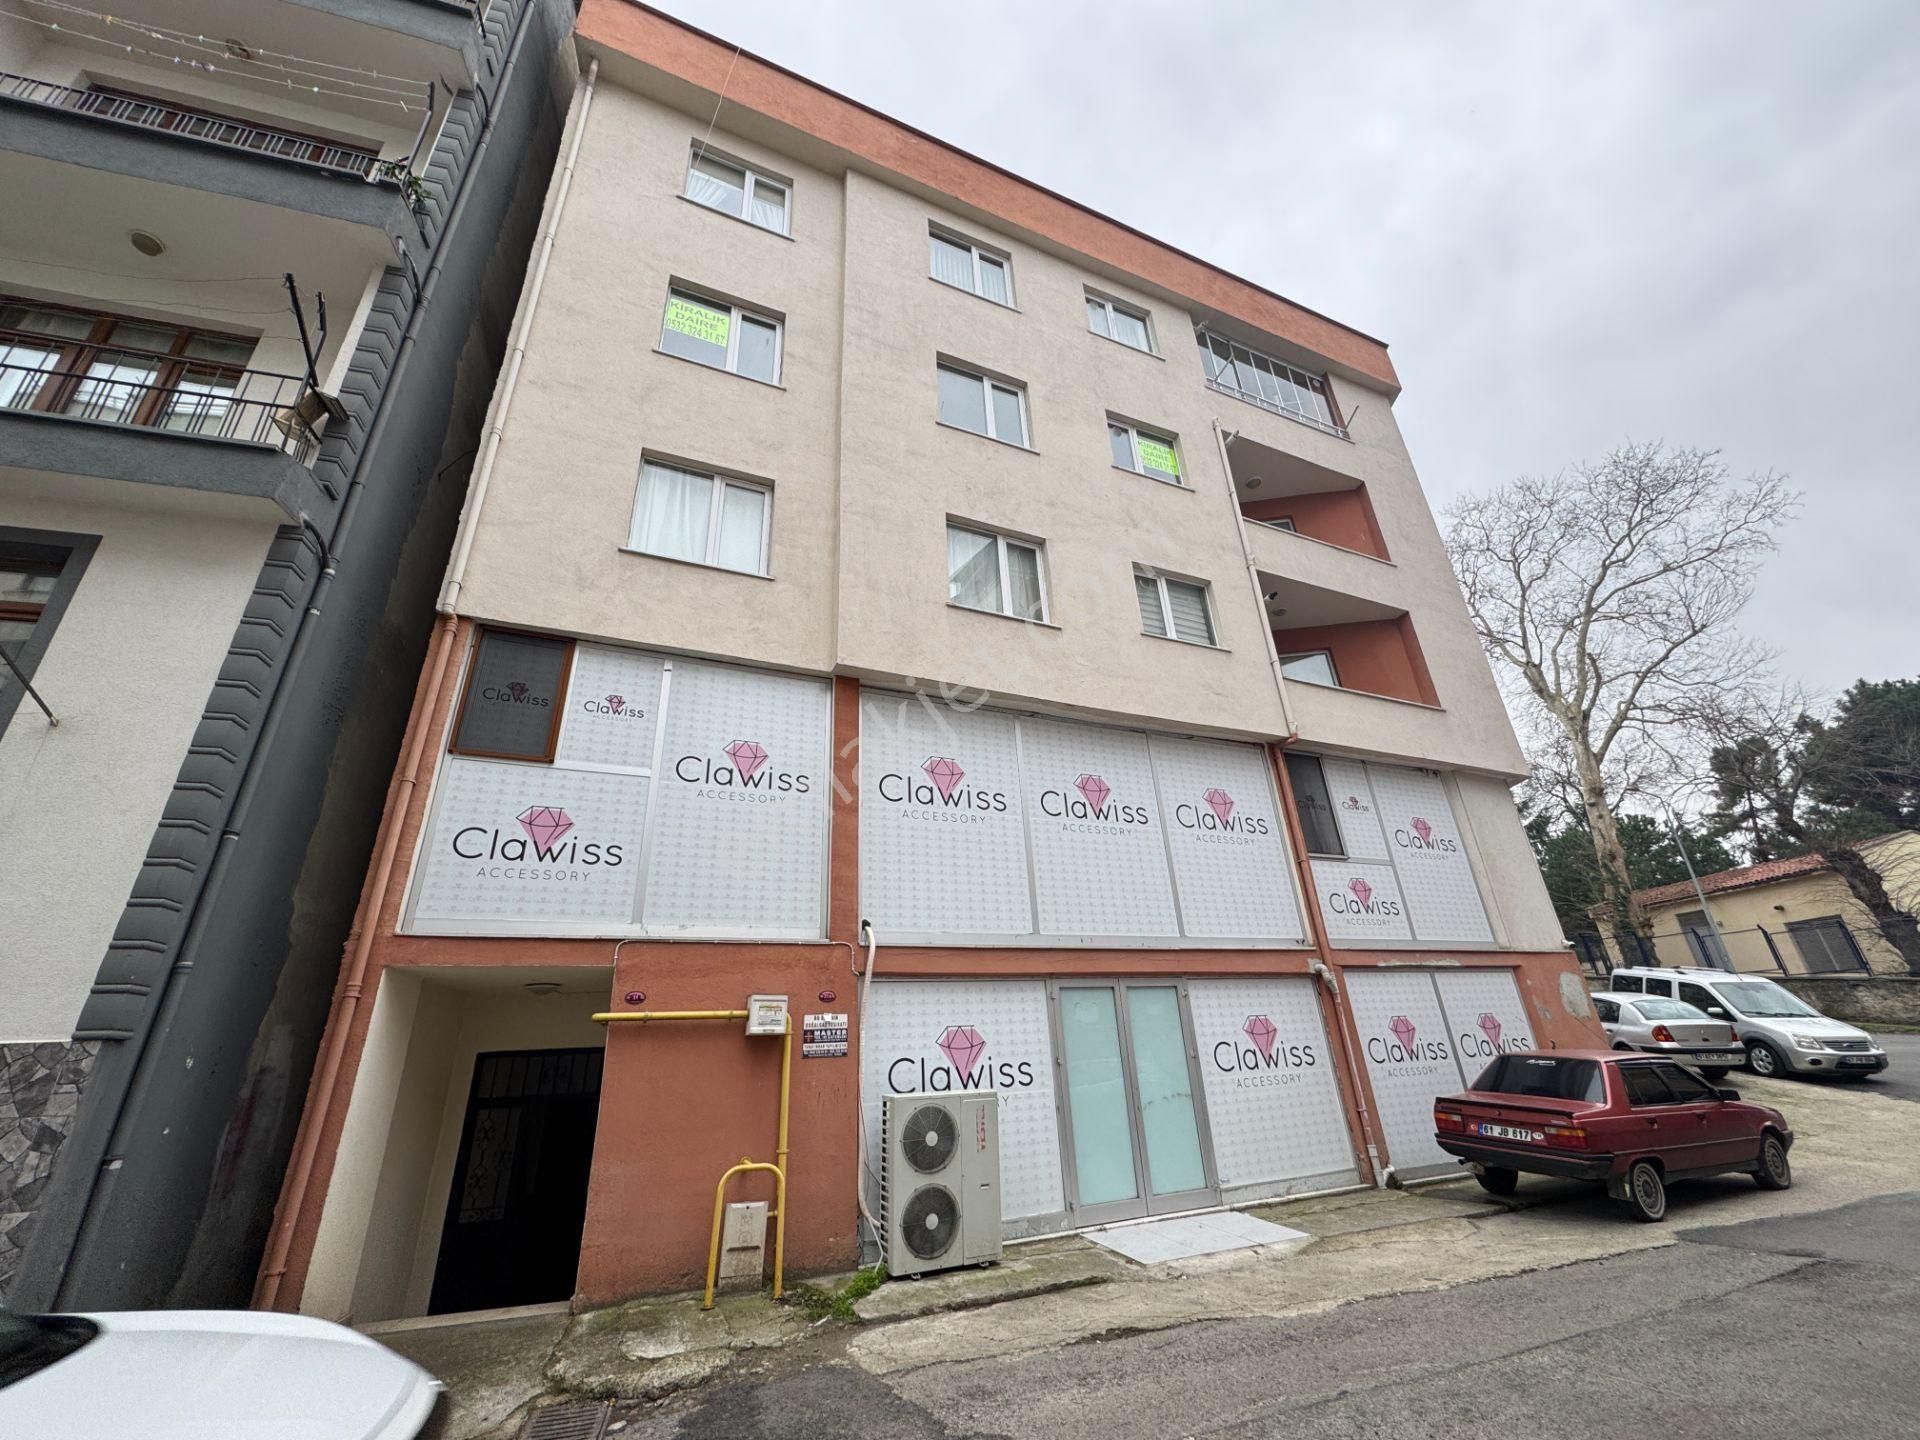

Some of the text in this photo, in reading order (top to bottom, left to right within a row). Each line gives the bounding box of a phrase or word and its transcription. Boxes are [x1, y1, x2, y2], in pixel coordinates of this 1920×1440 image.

[667, 318, 686, 331] 0532
[482, 686, 549, 707] Clawiss
[584, 700, 645, 719] Clawiss
[675, 755, 811, 794] Clawiss
[696, 789, 787, 805] ACCESSORY
[879, 773, 1008, 813] Clawiss
[902, 808, 986, 825] ACCESSORY
[1040, 790, 1149, 826] Clawiss
[1062, 822, 1133, 837] ACCESSORY
[1175, 803, 1269, 836] Clawiss
[452, 826, 624, 867] Clawiss
[1195, 833, 1256, 847] ACCESSORY
[1394, 829, 1457, 852] Clawiss
[476, 866, 591, 882] ACCESSORY
[1329, 893, 1400, 916] Clawiss
[1214, 1041, 1316, 1073] Clawiss
[1368, 1037, 1448, 1064] Clawiss
[888, 1056, 1034, 1094] Clawiss
[1236, 1073, 1303, 1089] ACCESSORY
[1388, 1066, 1438, 1078] ACCESSORY
[1483, 1124, 1493, 1134] 61
[1498, 1127, 1509, 1137] JB
